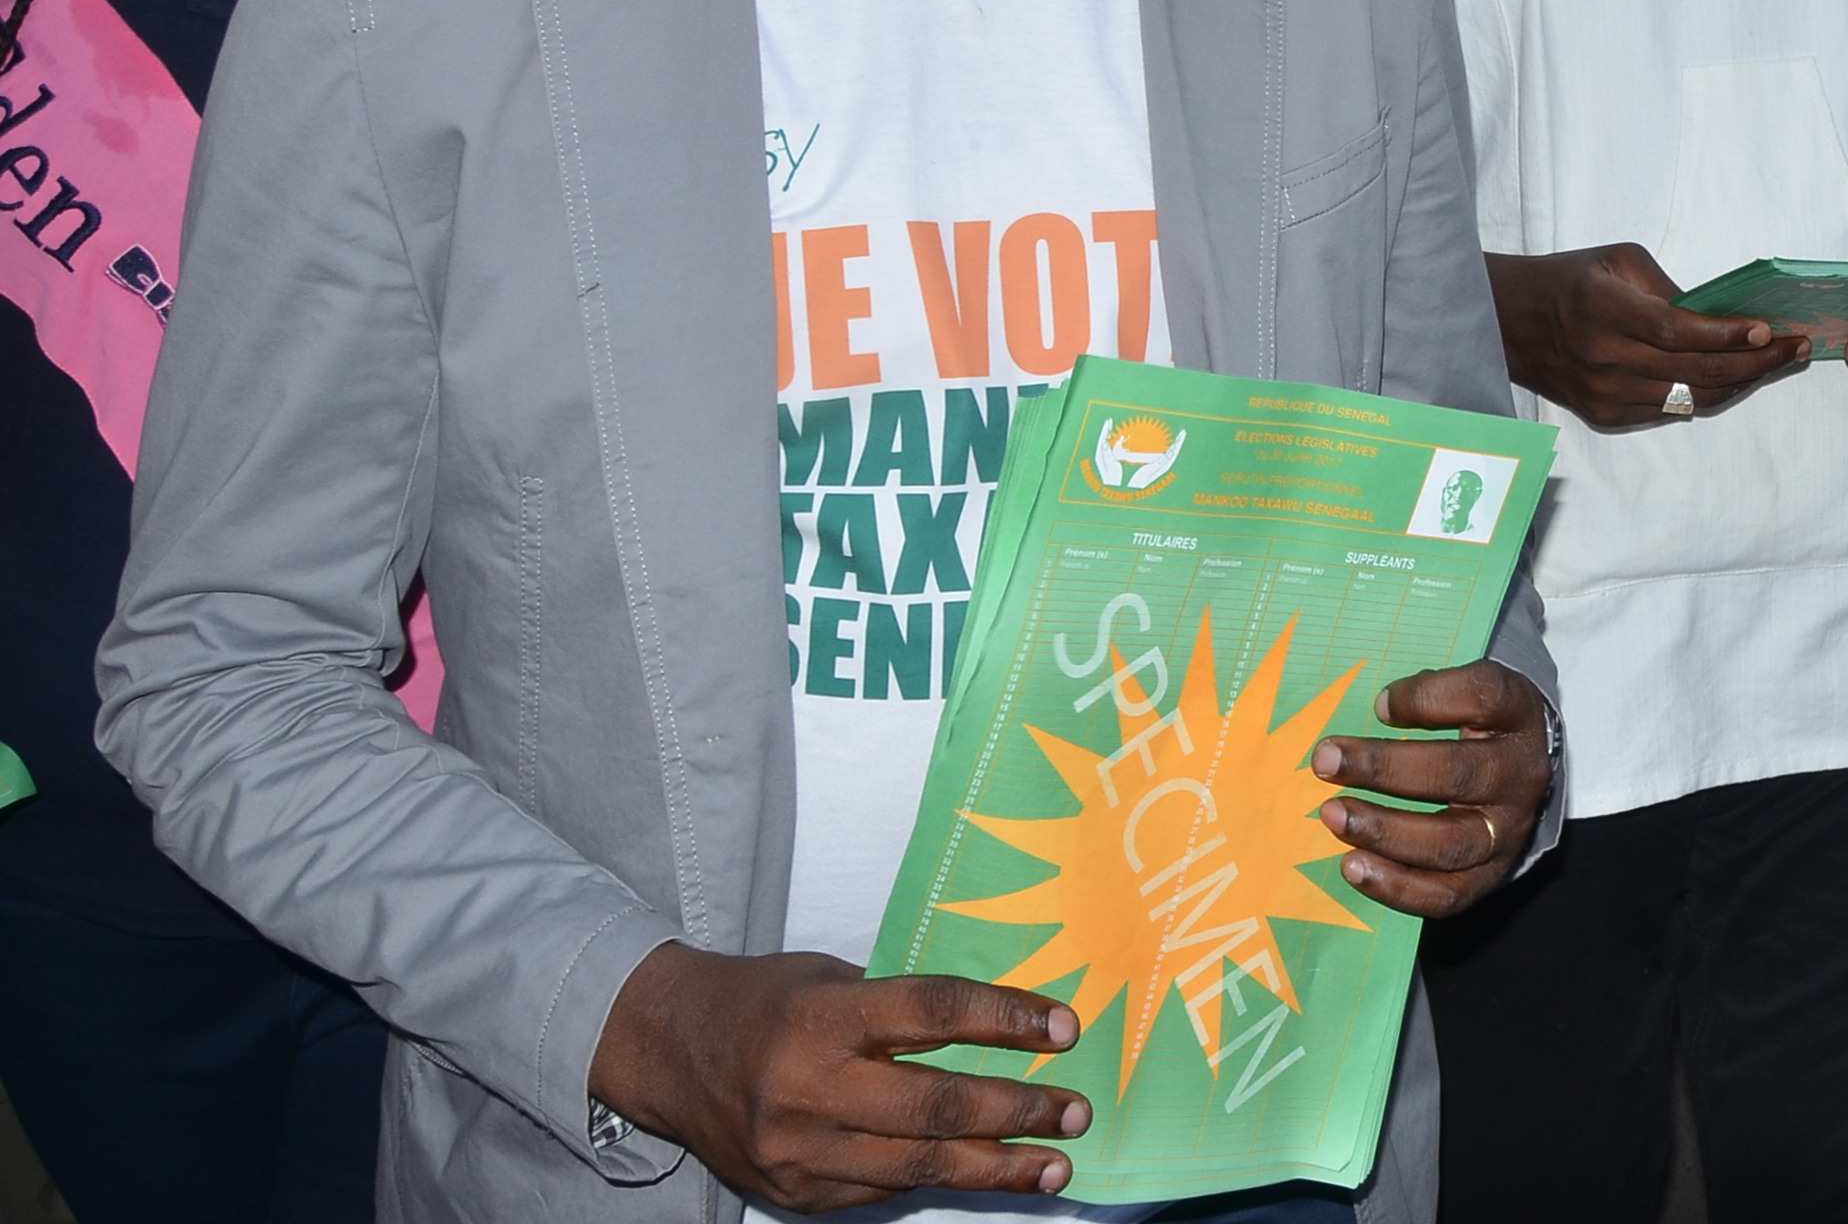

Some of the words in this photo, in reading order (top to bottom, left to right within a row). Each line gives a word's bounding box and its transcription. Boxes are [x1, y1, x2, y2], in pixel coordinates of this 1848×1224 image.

[906, 210, 1174, 378] VOT
[1316, 403, 1334, 415] DU
[777, 383, 1048, 487] MAN
[1193, 492, 1249, 508] MANKOO
[1252, 496, 1303, 512] TAXAWU
[1305, 502, 1376, 523] SENEGAAL
[780, 489, 998, 595] TAX
[1131, 532, 1198, 551] TITULAIRES
[1144, 553, 1163, 563] Nom
[1202, 558, 1242, 568] Profession
[1345, 550, 1416, 571] SUPPLÉANTS
[1357, 571, 1375, 581] Nom
[1412, 576, 1451, 589] Profession
[1053, 592, 1306, 1115] SPECIMEN
